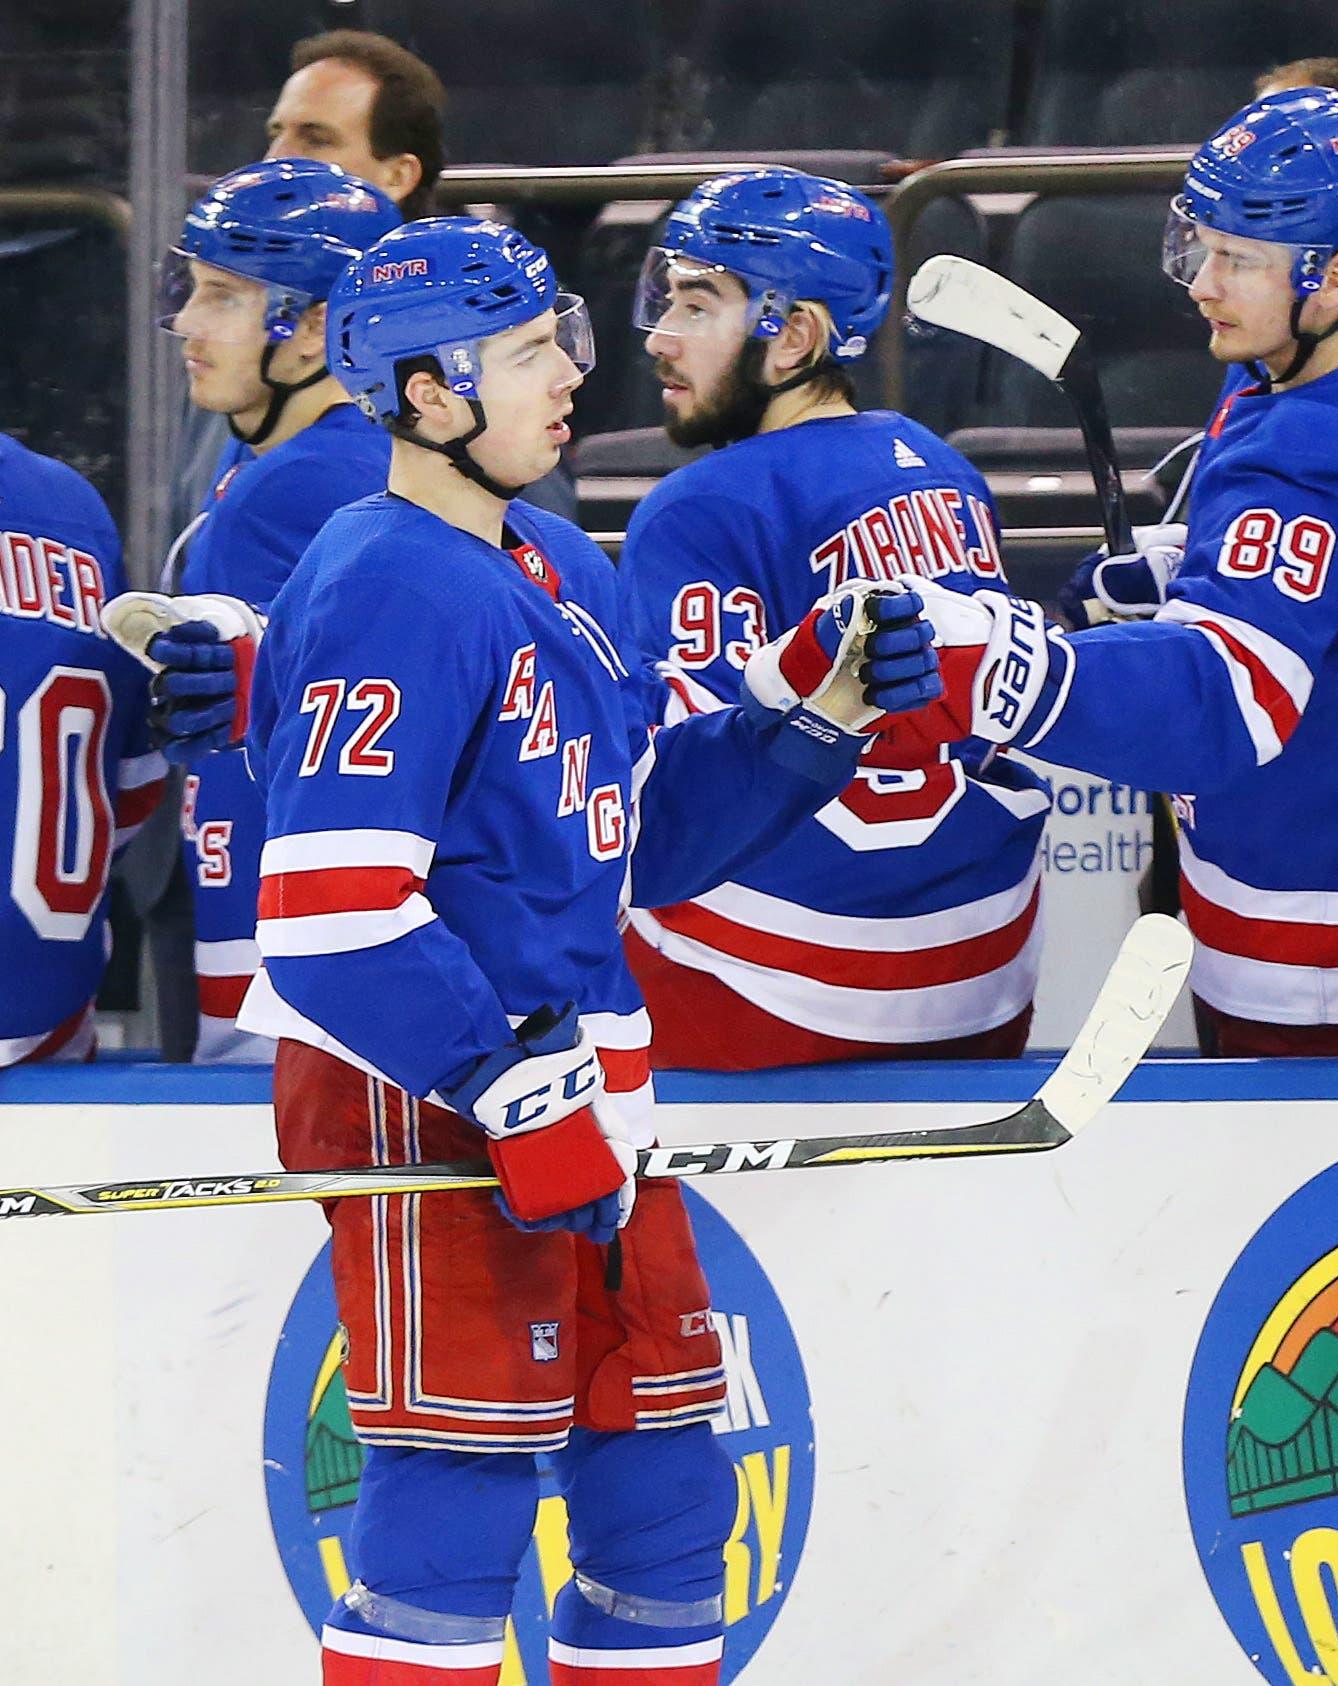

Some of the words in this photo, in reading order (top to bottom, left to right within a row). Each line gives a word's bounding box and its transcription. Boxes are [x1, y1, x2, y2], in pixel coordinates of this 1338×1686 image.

[372, 257, 428, 283] NYR
[809, 488, 1008, 597] ZIBANEJ
[1215, 507, 1338, 603] 89
[669, 580, 768, 672] 93
[299, 678, 402, 777] 72
[0, 664, 114, 942] 0
[1046, 774, 1152, 815] orth
